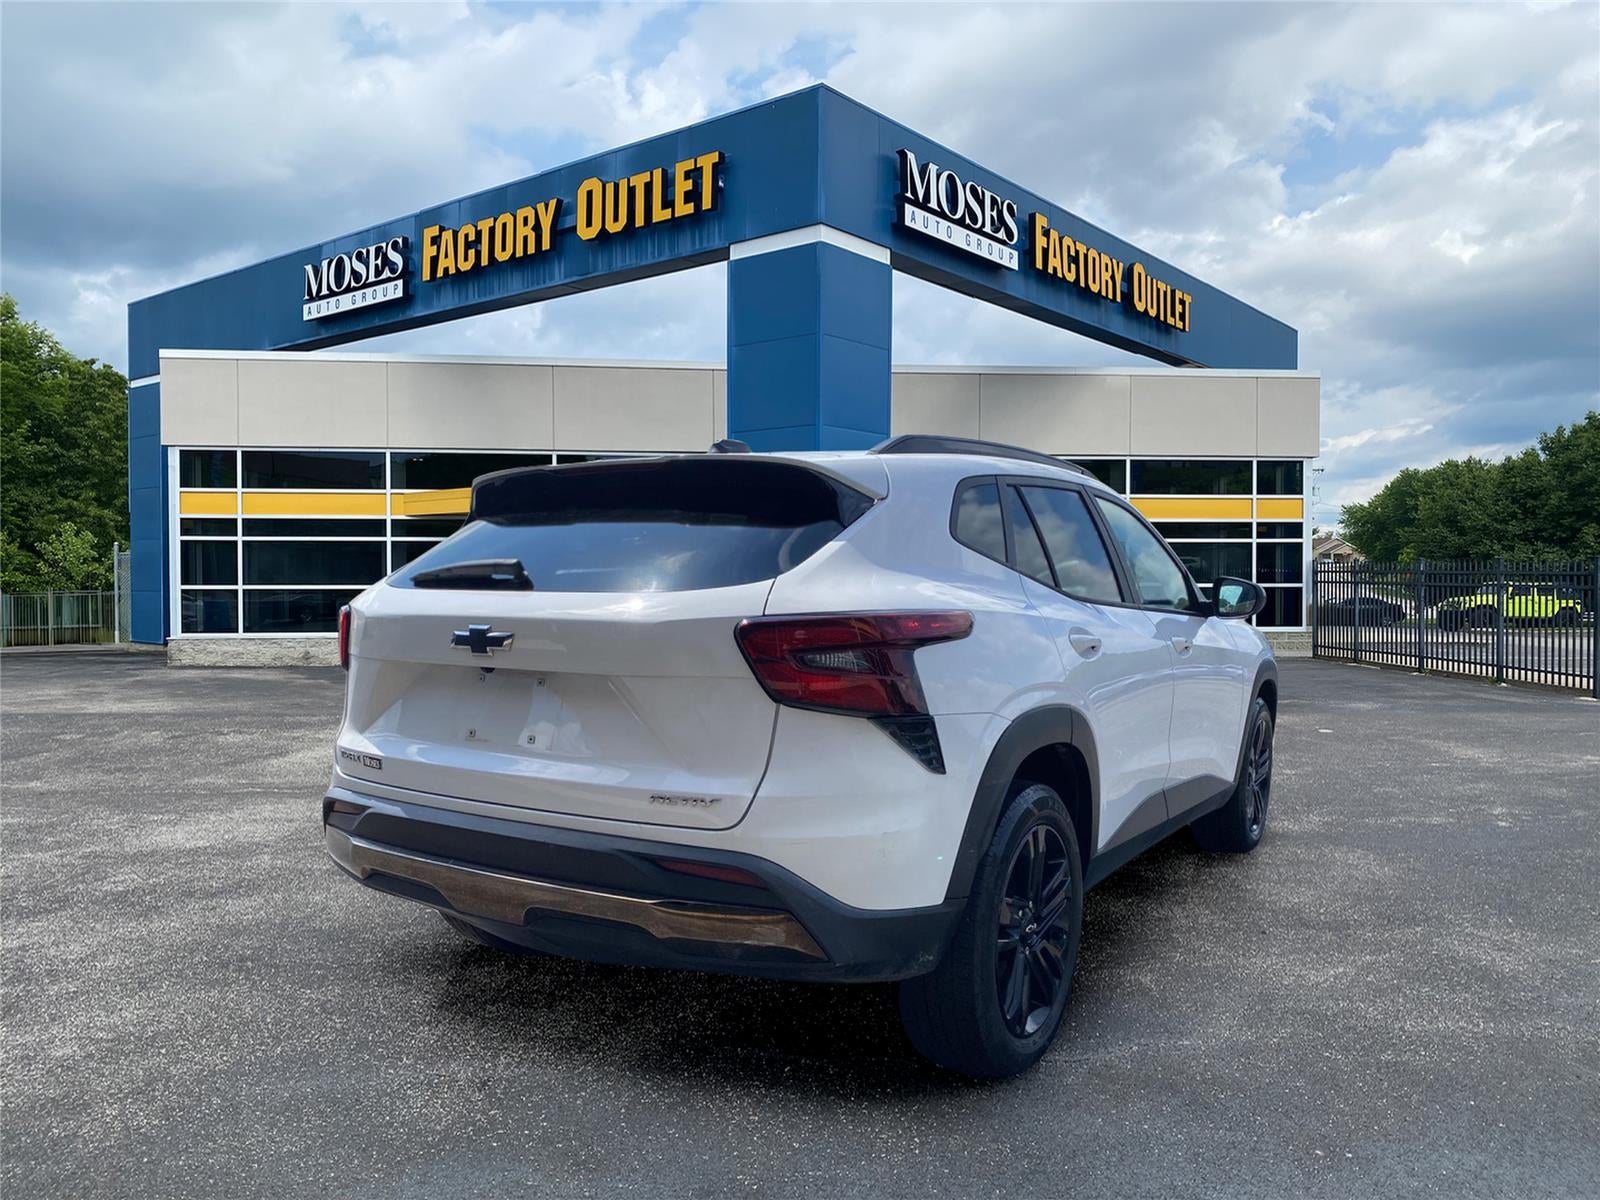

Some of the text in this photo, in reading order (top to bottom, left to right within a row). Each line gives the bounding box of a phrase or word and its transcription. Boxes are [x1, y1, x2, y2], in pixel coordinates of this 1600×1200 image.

[422, 151, 721, 282] FACTORY OUTLET
[904, 149, 1019, 245] MOSES
[909, 209, 1015, 264] AUTO GROUP
[303, 236, 404, 300] MOSES
[306, 283, 400, 318] AUTO GROUP
[1034, 212, 1192, 332] FACTORY OUTLET
